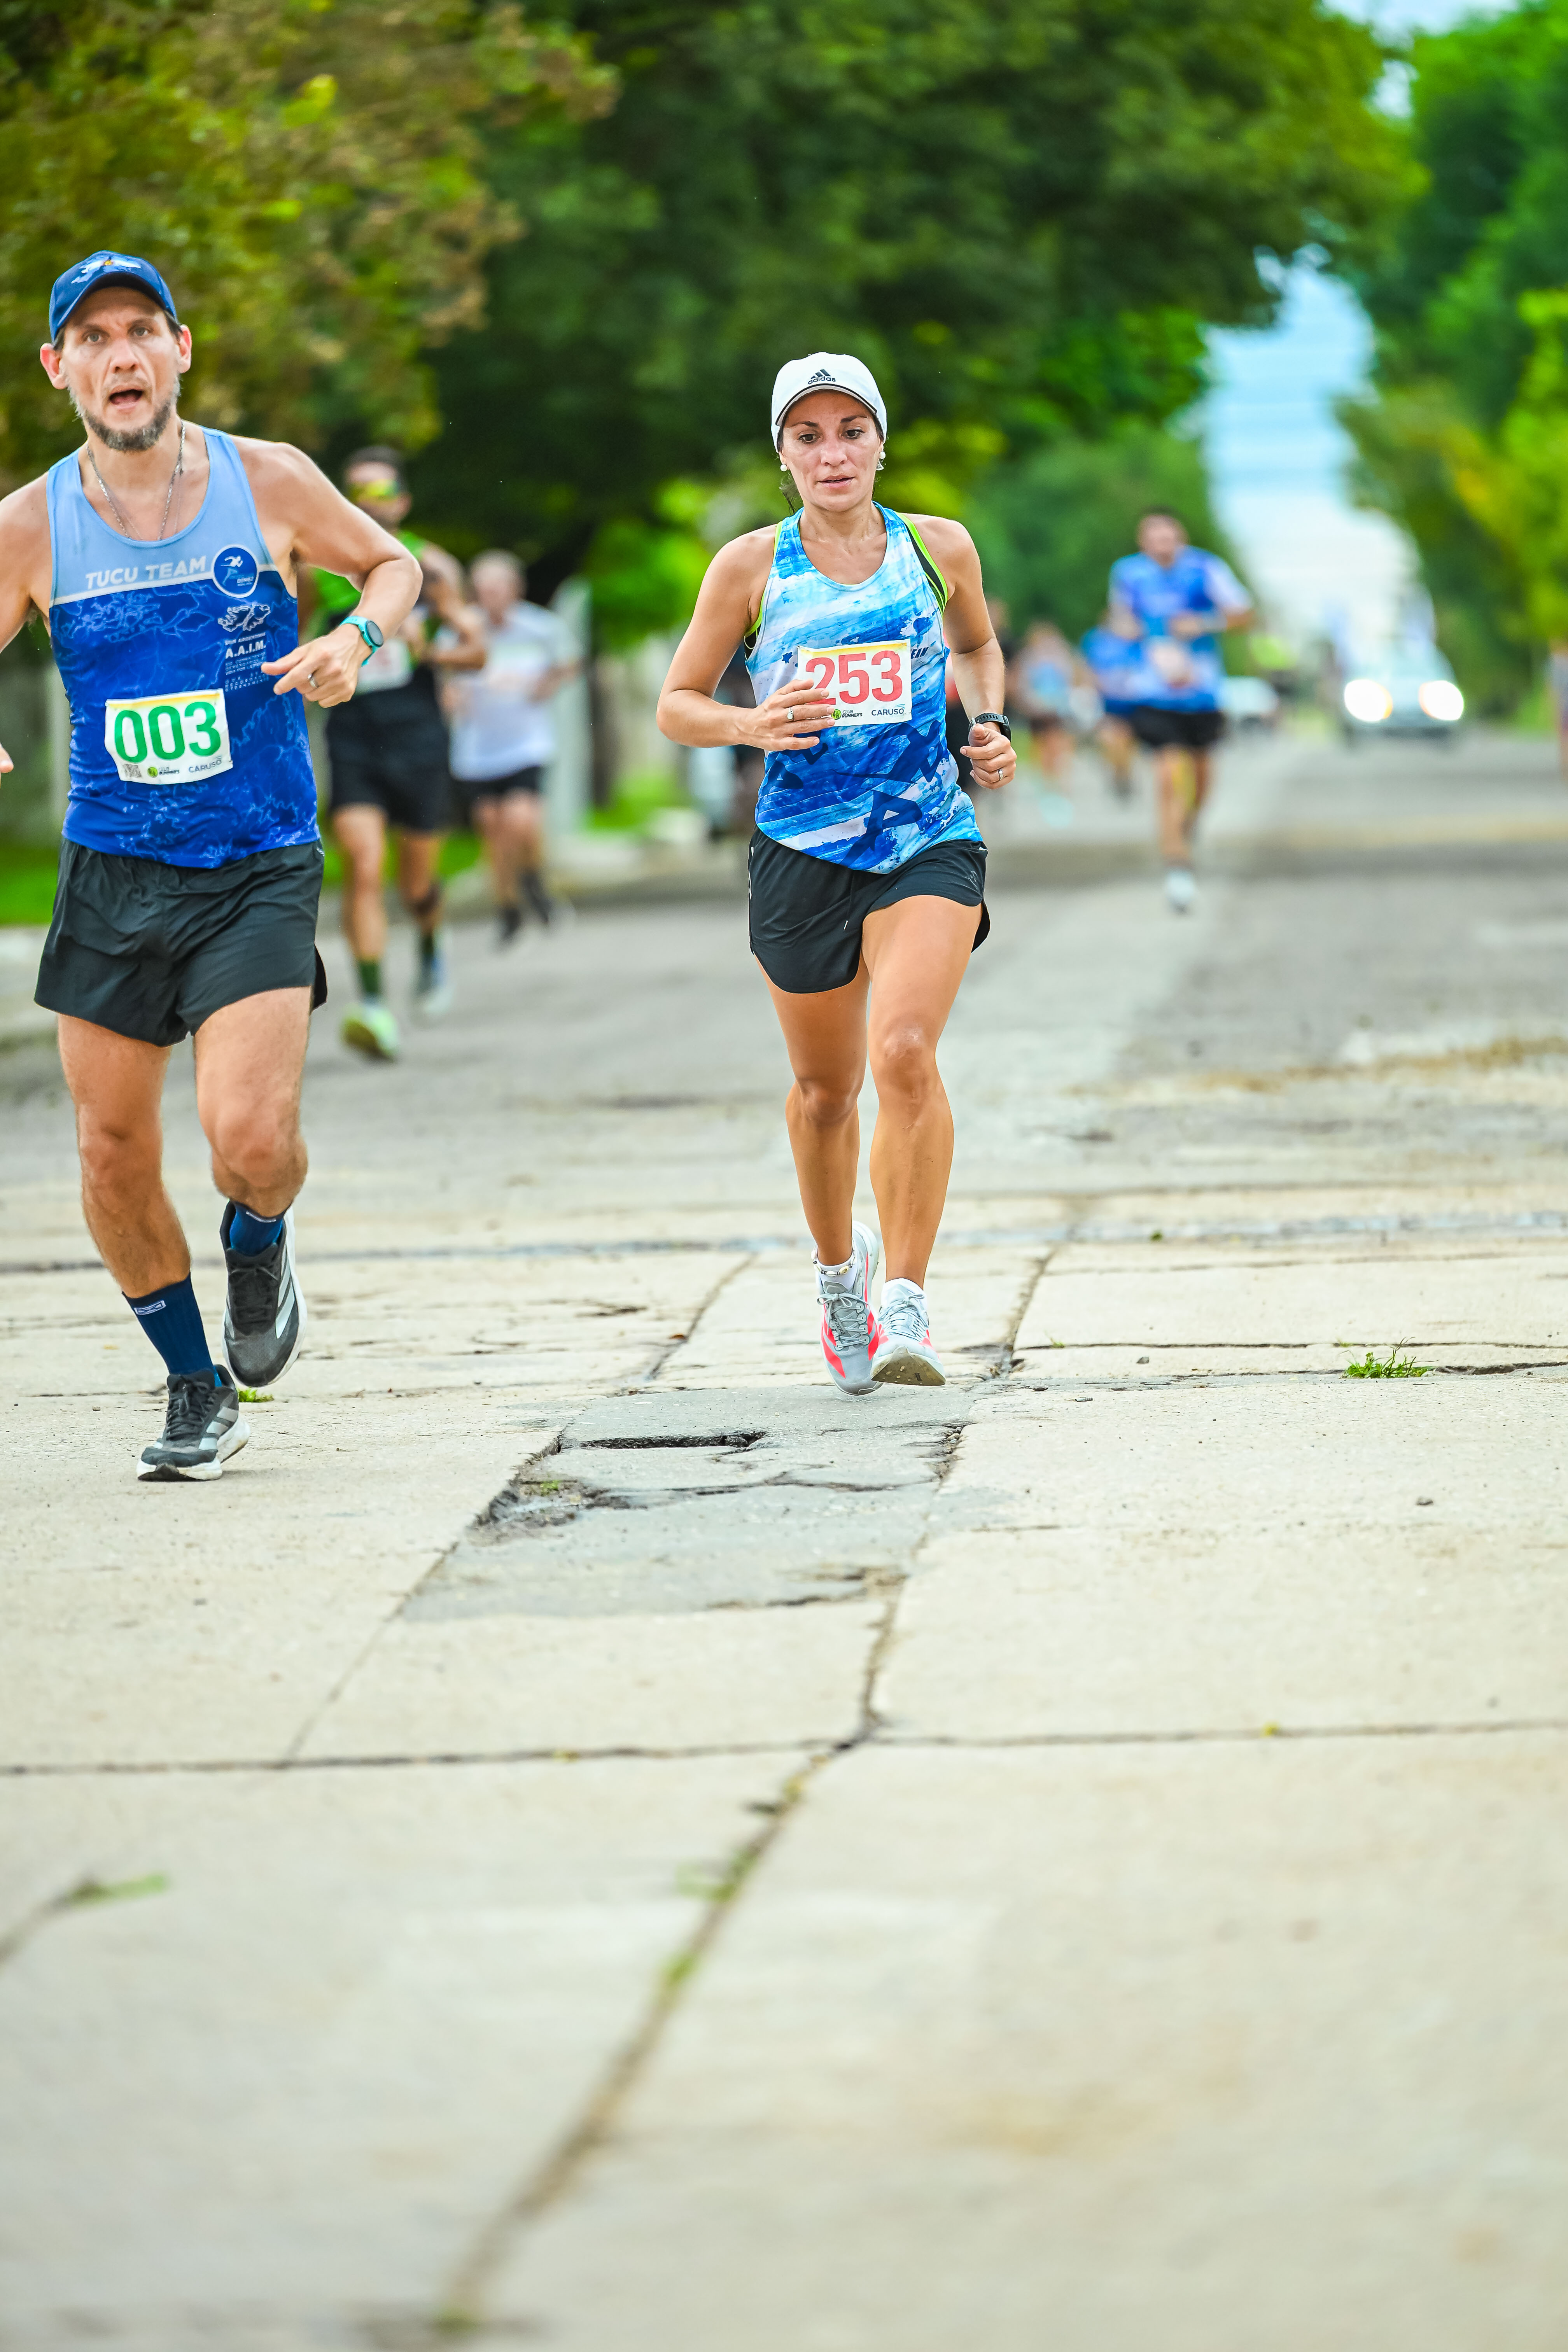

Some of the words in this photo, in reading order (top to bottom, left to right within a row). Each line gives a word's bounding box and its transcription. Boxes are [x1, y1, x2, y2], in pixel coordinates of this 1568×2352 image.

[808, 376, 836, 385] adidas
[85, 567, 138, 590] TUCU
[145, 555, 206, 580] TEAM
[225, 640, 266, 659] A.A.I.M.
[805, 650, 903, 705] 253
[114, 702, 221, 763] 003
[188, 759, 222, 773] CARUSO
